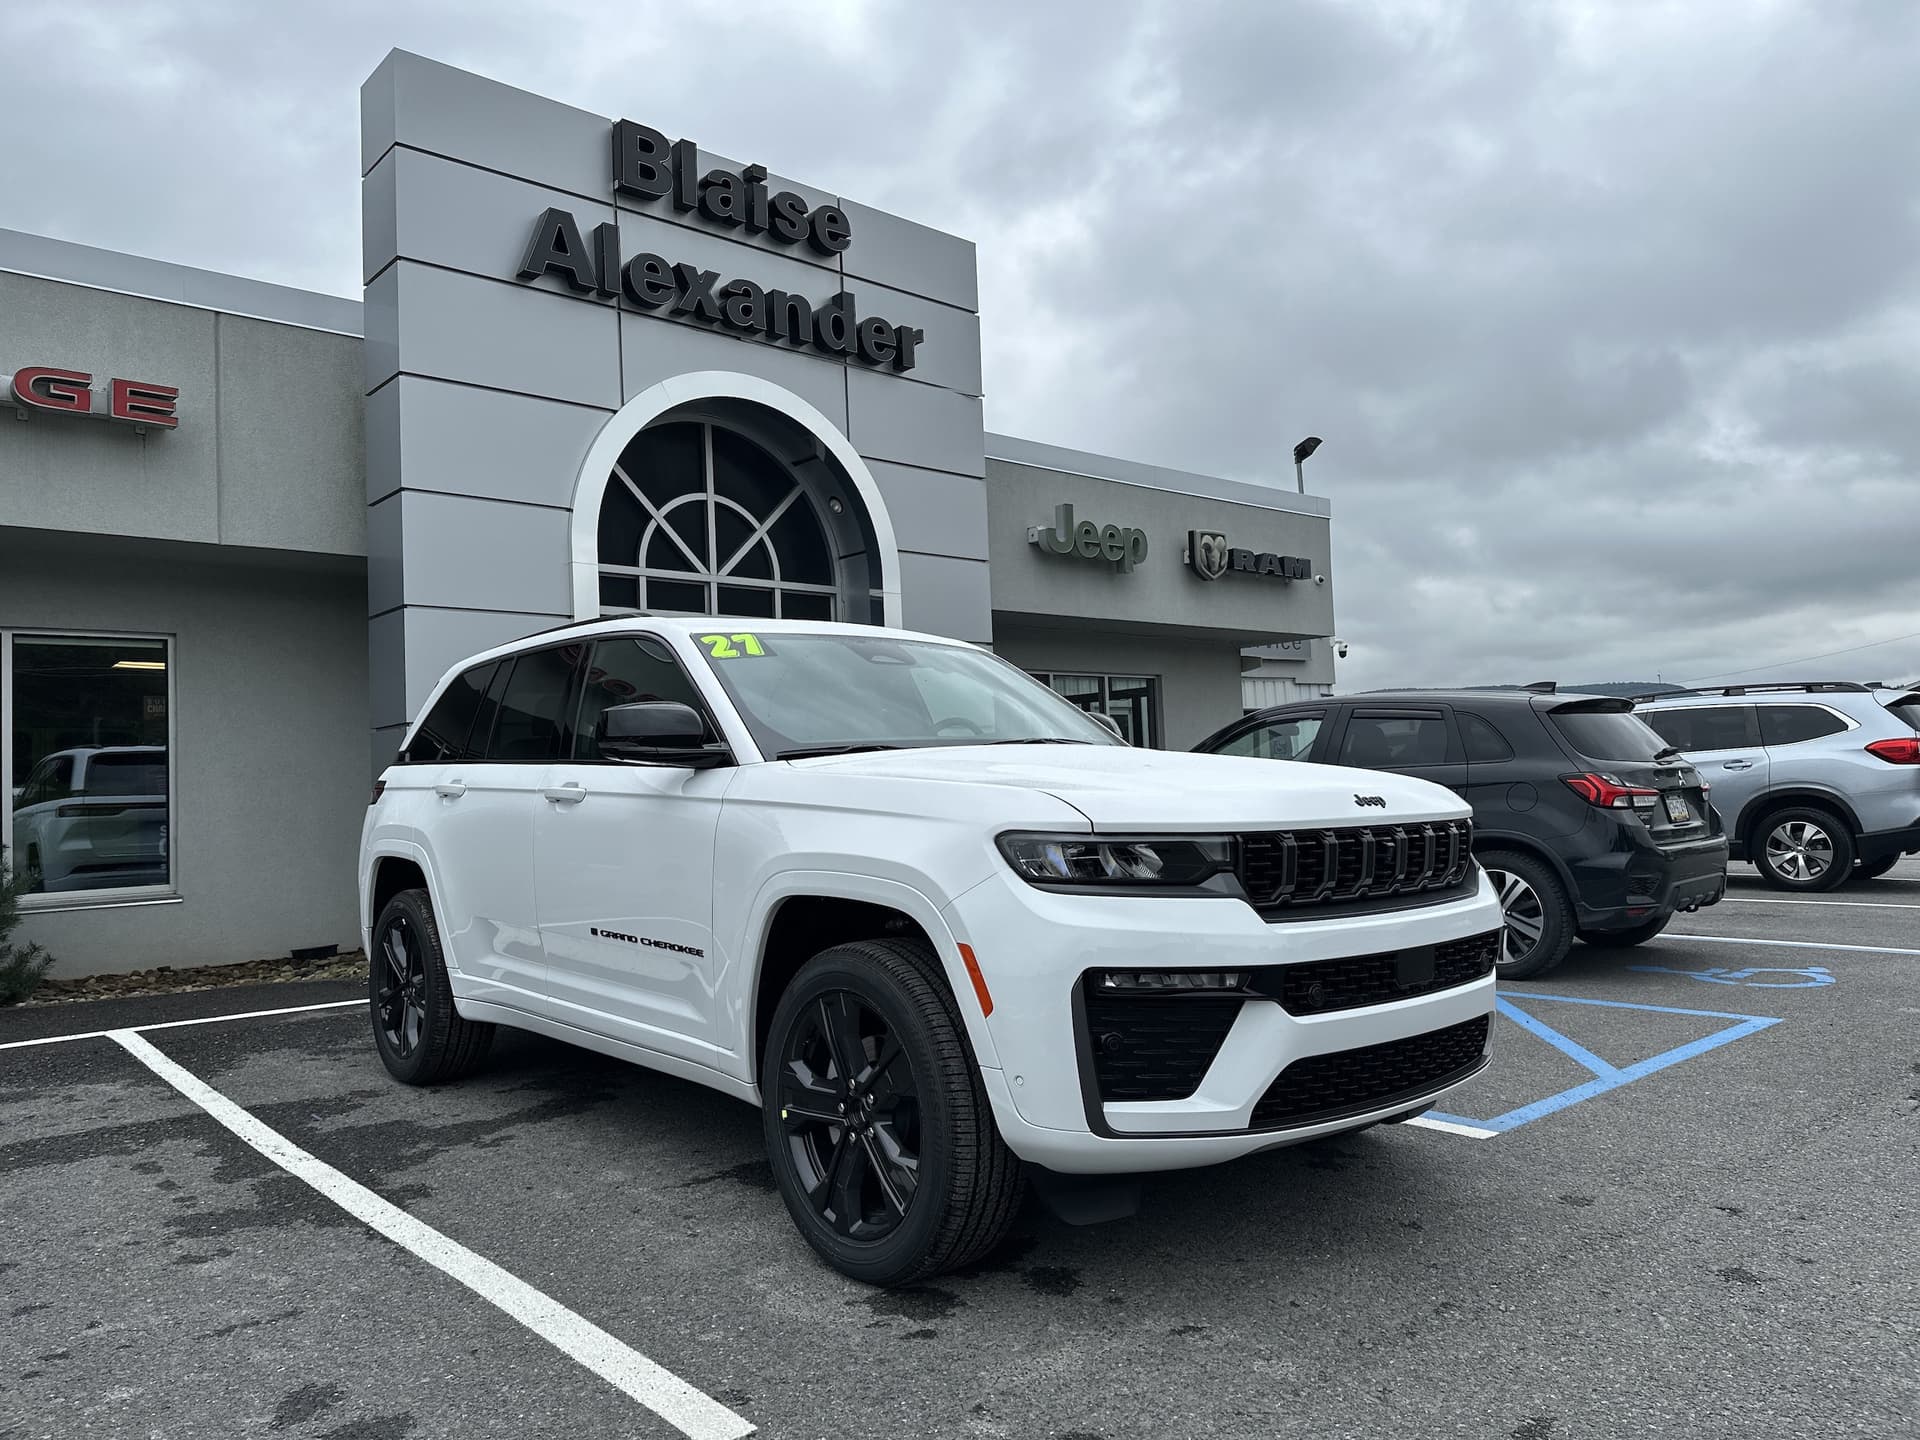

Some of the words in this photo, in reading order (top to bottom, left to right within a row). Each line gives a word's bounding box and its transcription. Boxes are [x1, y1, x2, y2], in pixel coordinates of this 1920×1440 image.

[613, 118, 852, 256] Blaise
[516, 206, 924, 373] Alexander
[11, 366, 179, 430] GE
[1037, 503, 1148, 574] Jeep
[1228, 548, 1311, 580] RAM
[700, 633, 765, 658] 27
[1353, 794, 1386, 808] Jeep
[600, 929, 638, 944] GRAND
[640, 937, 705, 958] CHEROKEE
